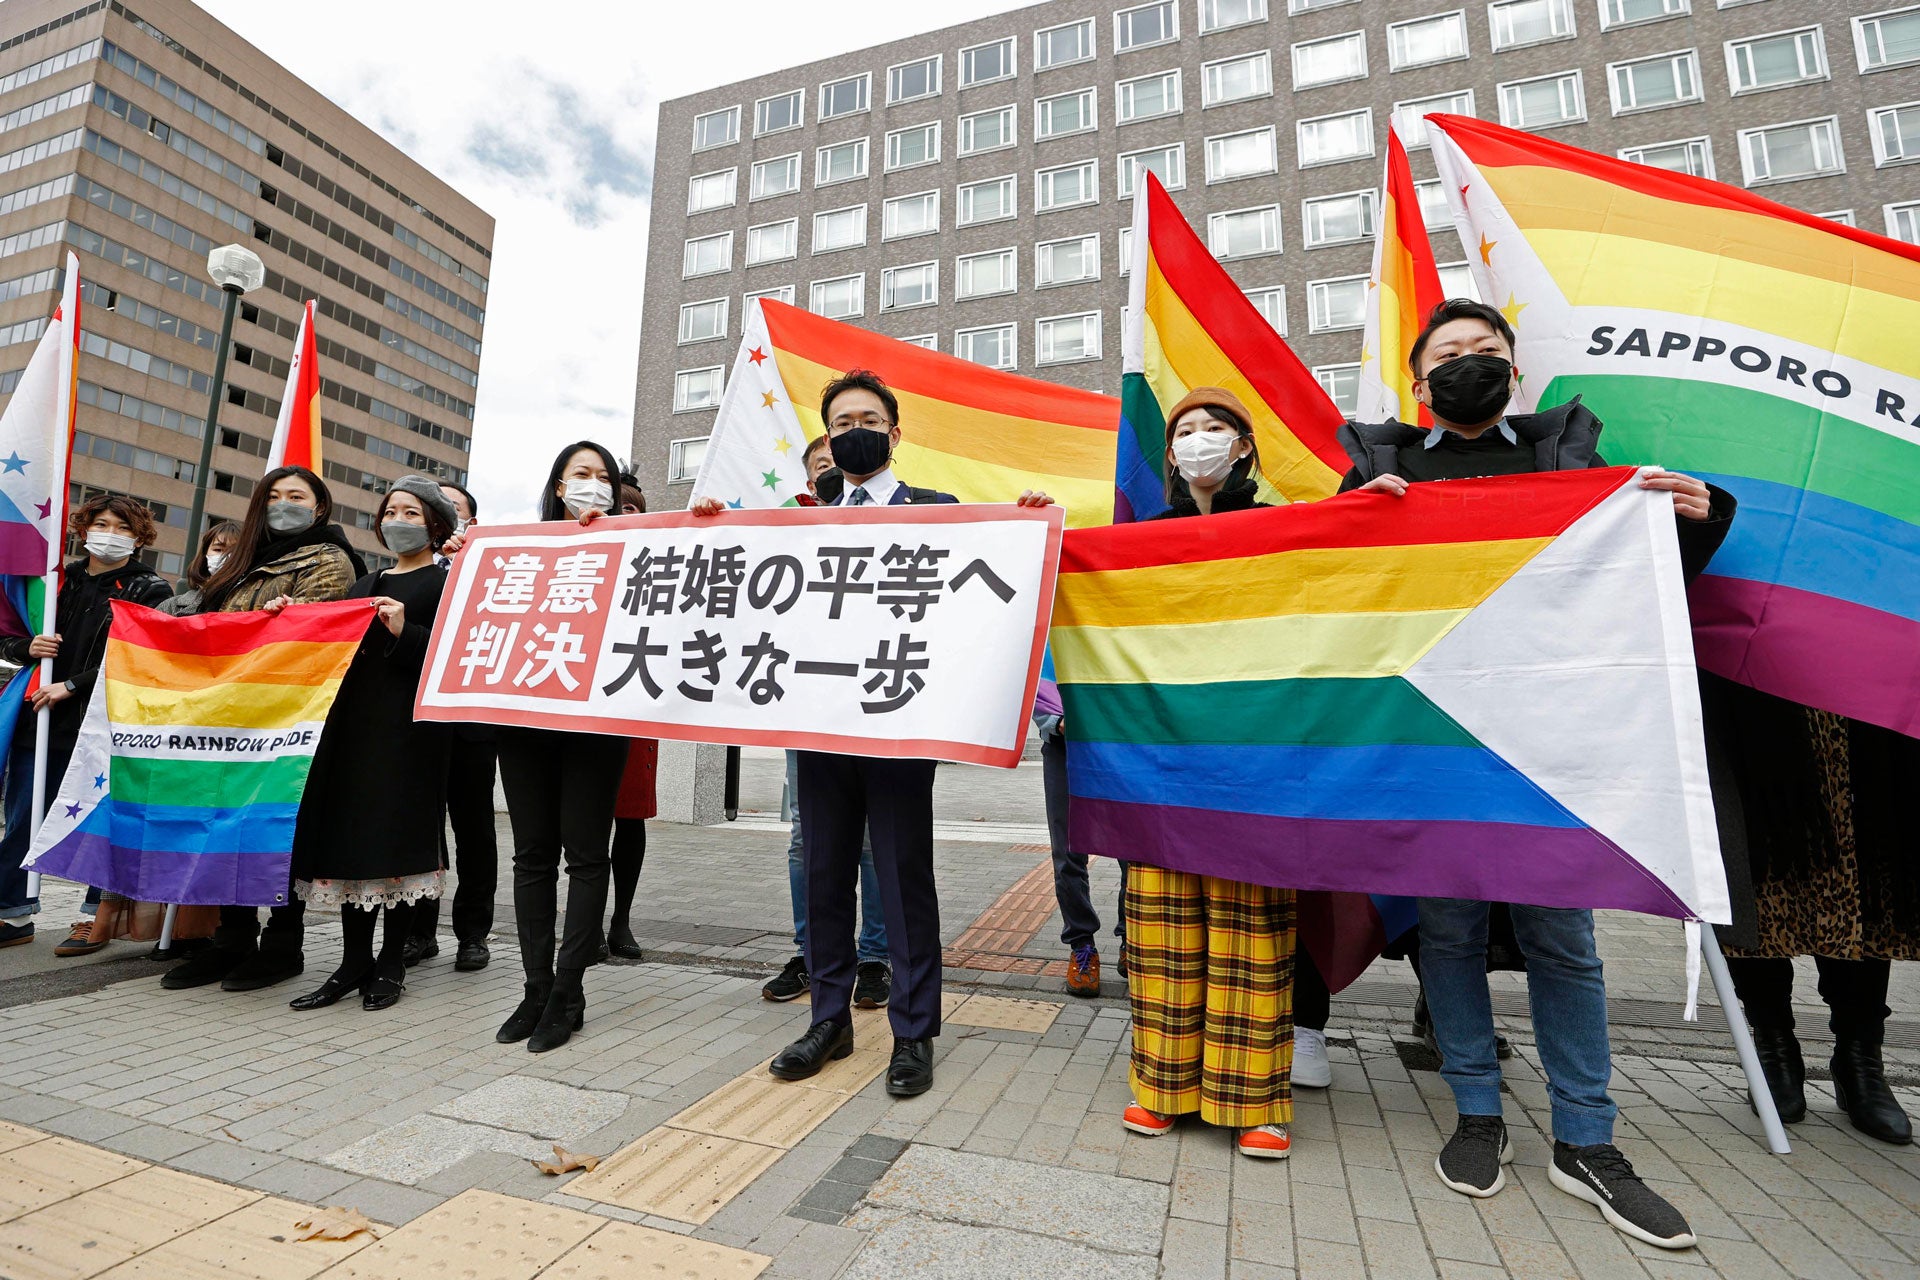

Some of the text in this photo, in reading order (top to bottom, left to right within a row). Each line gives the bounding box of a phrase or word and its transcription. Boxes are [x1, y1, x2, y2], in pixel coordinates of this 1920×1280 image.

[1586, 326, 1851, 398] SAPPORO
[476, 550, 609, 614] 違憲
[620, 542, 1017, 623] 結婚の平等へ
[458, 620, 587, 693] 判決
[602, 626, 931, 715] 大きな一歩
[110, 730, 314, 752] PPORO RAINBOW PIDE
[1576, 1159, 1613, 1200] new balance
